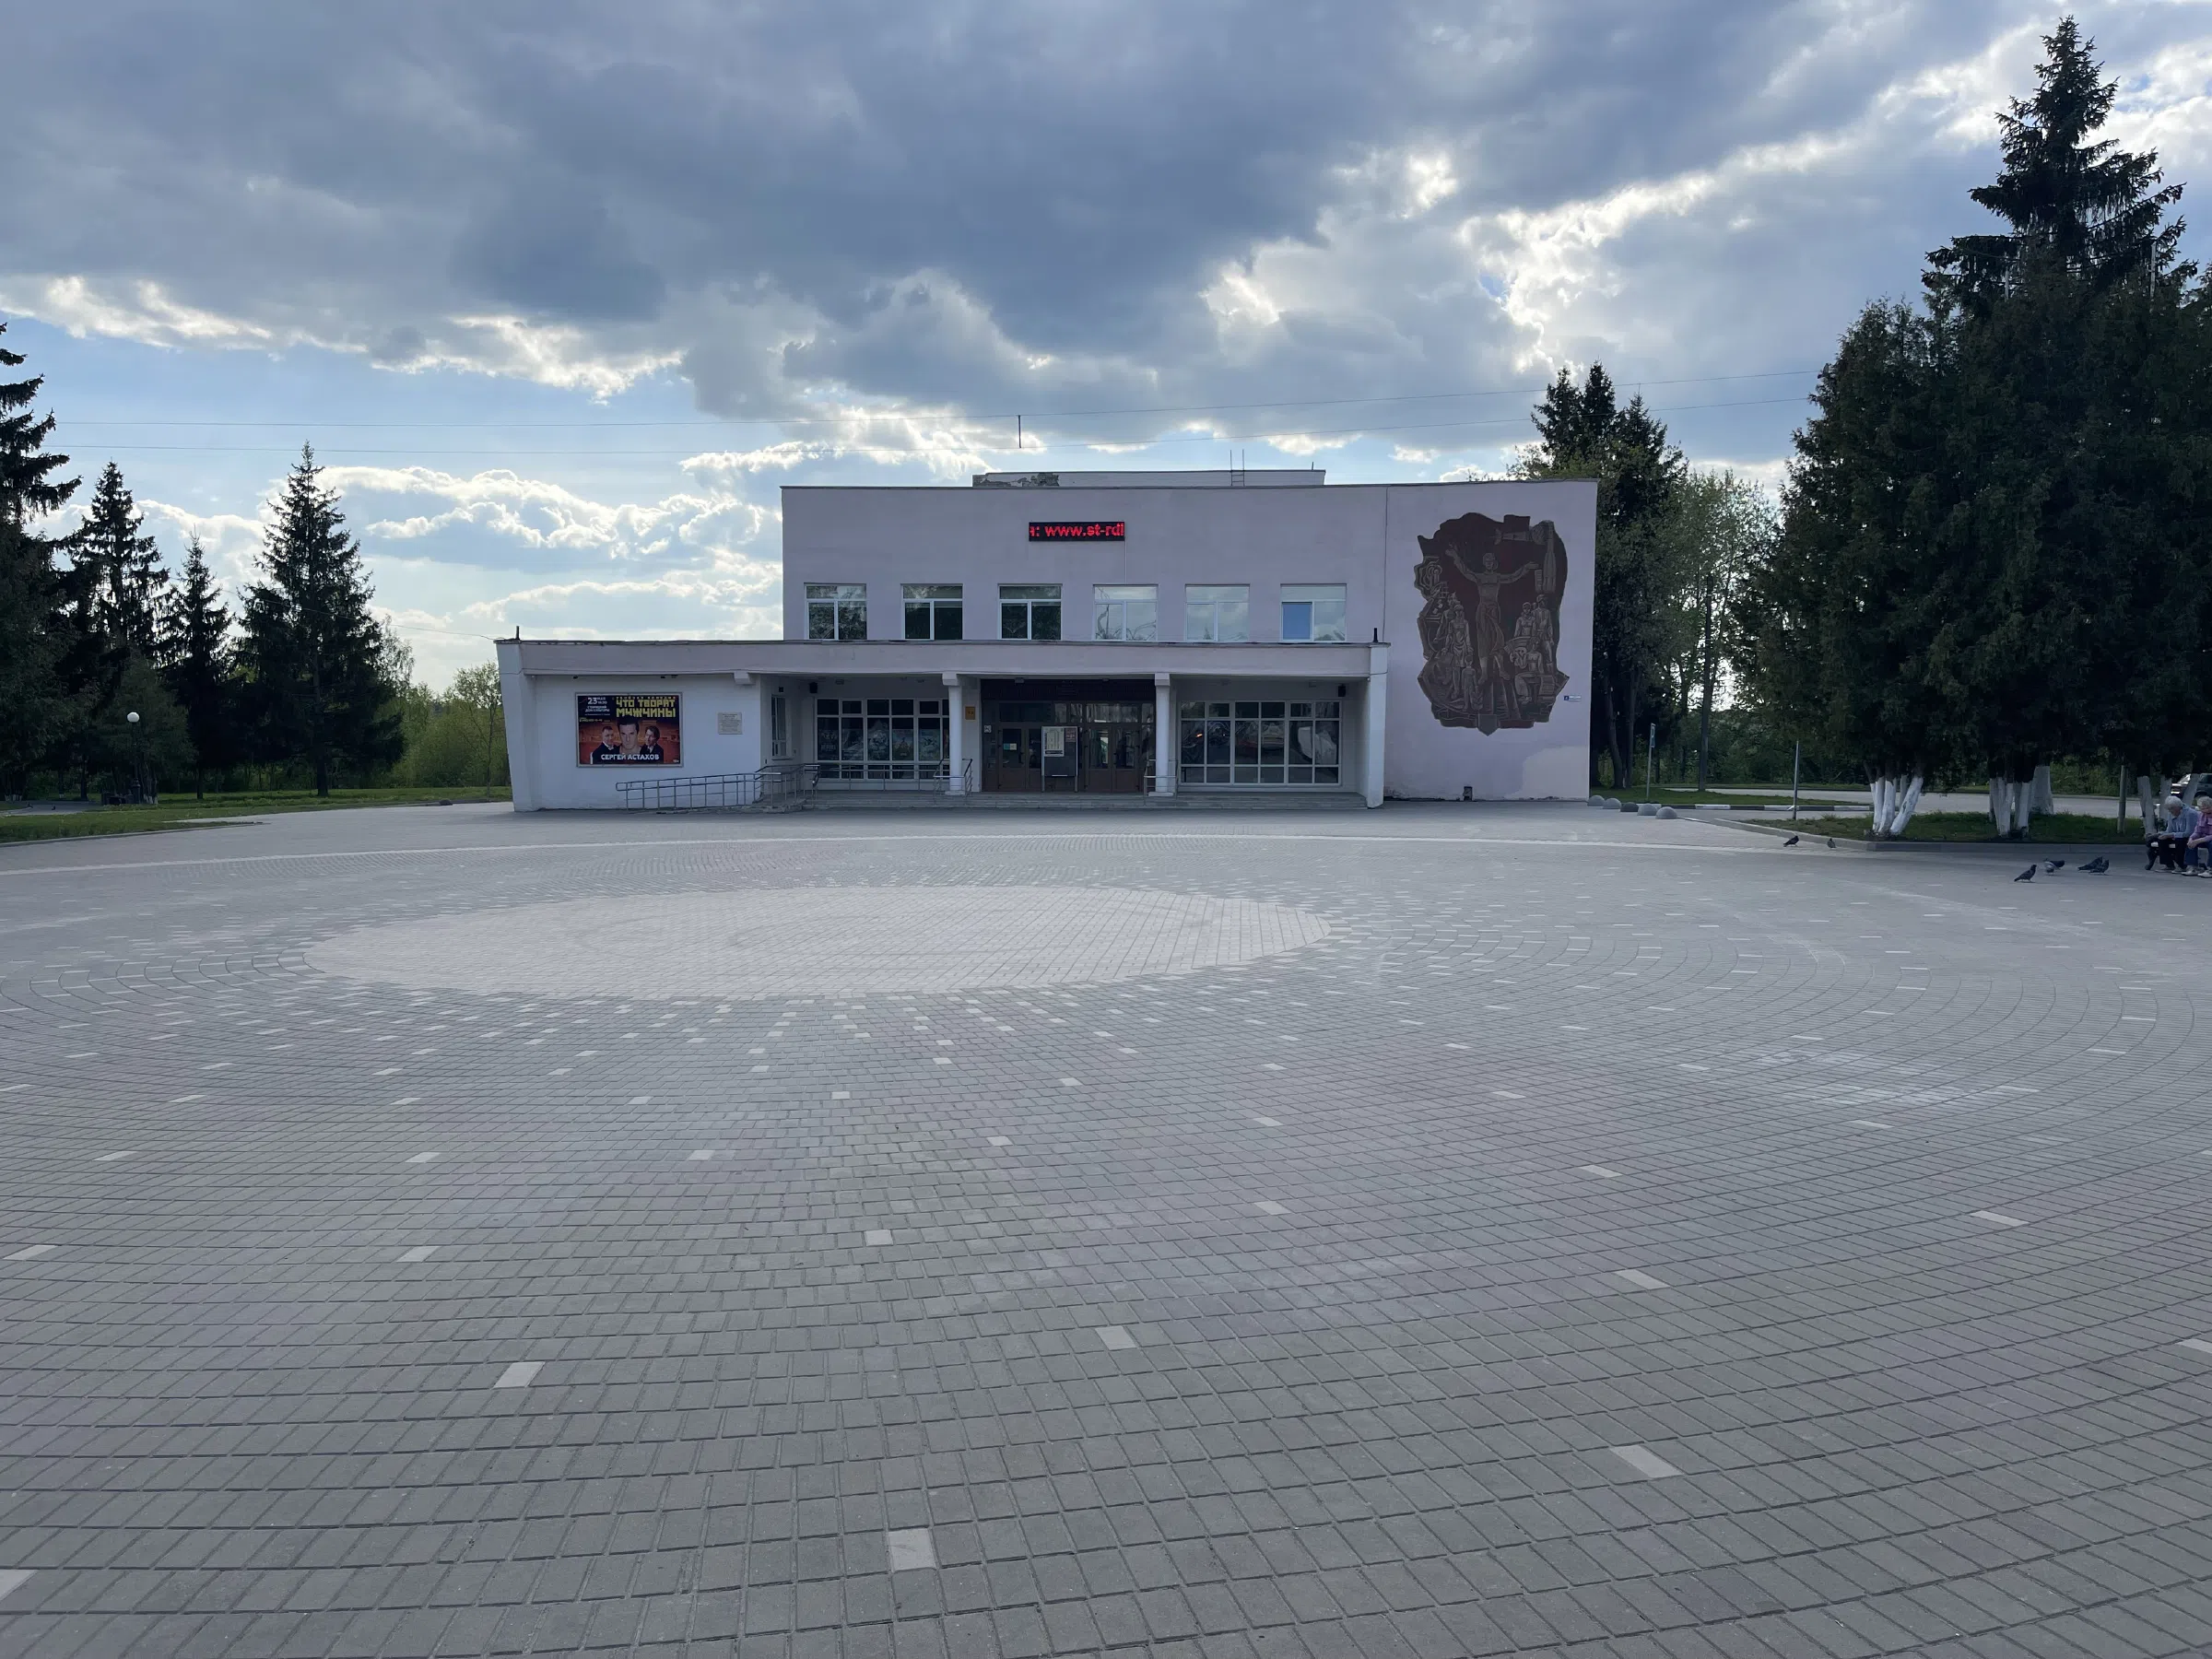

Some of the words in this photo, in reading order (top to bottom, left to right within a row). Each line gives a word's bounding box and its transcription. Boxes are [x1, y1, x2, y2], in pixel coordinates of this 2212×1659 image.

[587, 697, 598, 705] 23
[616, 700, 635, 708] ЧТО
[638, 700, 676, 708] ТВОРЯТ
[616, 708, 677, 718] МУЖЧИНЫ
[600, 752, 627, 760] СЕРГЕЙ
